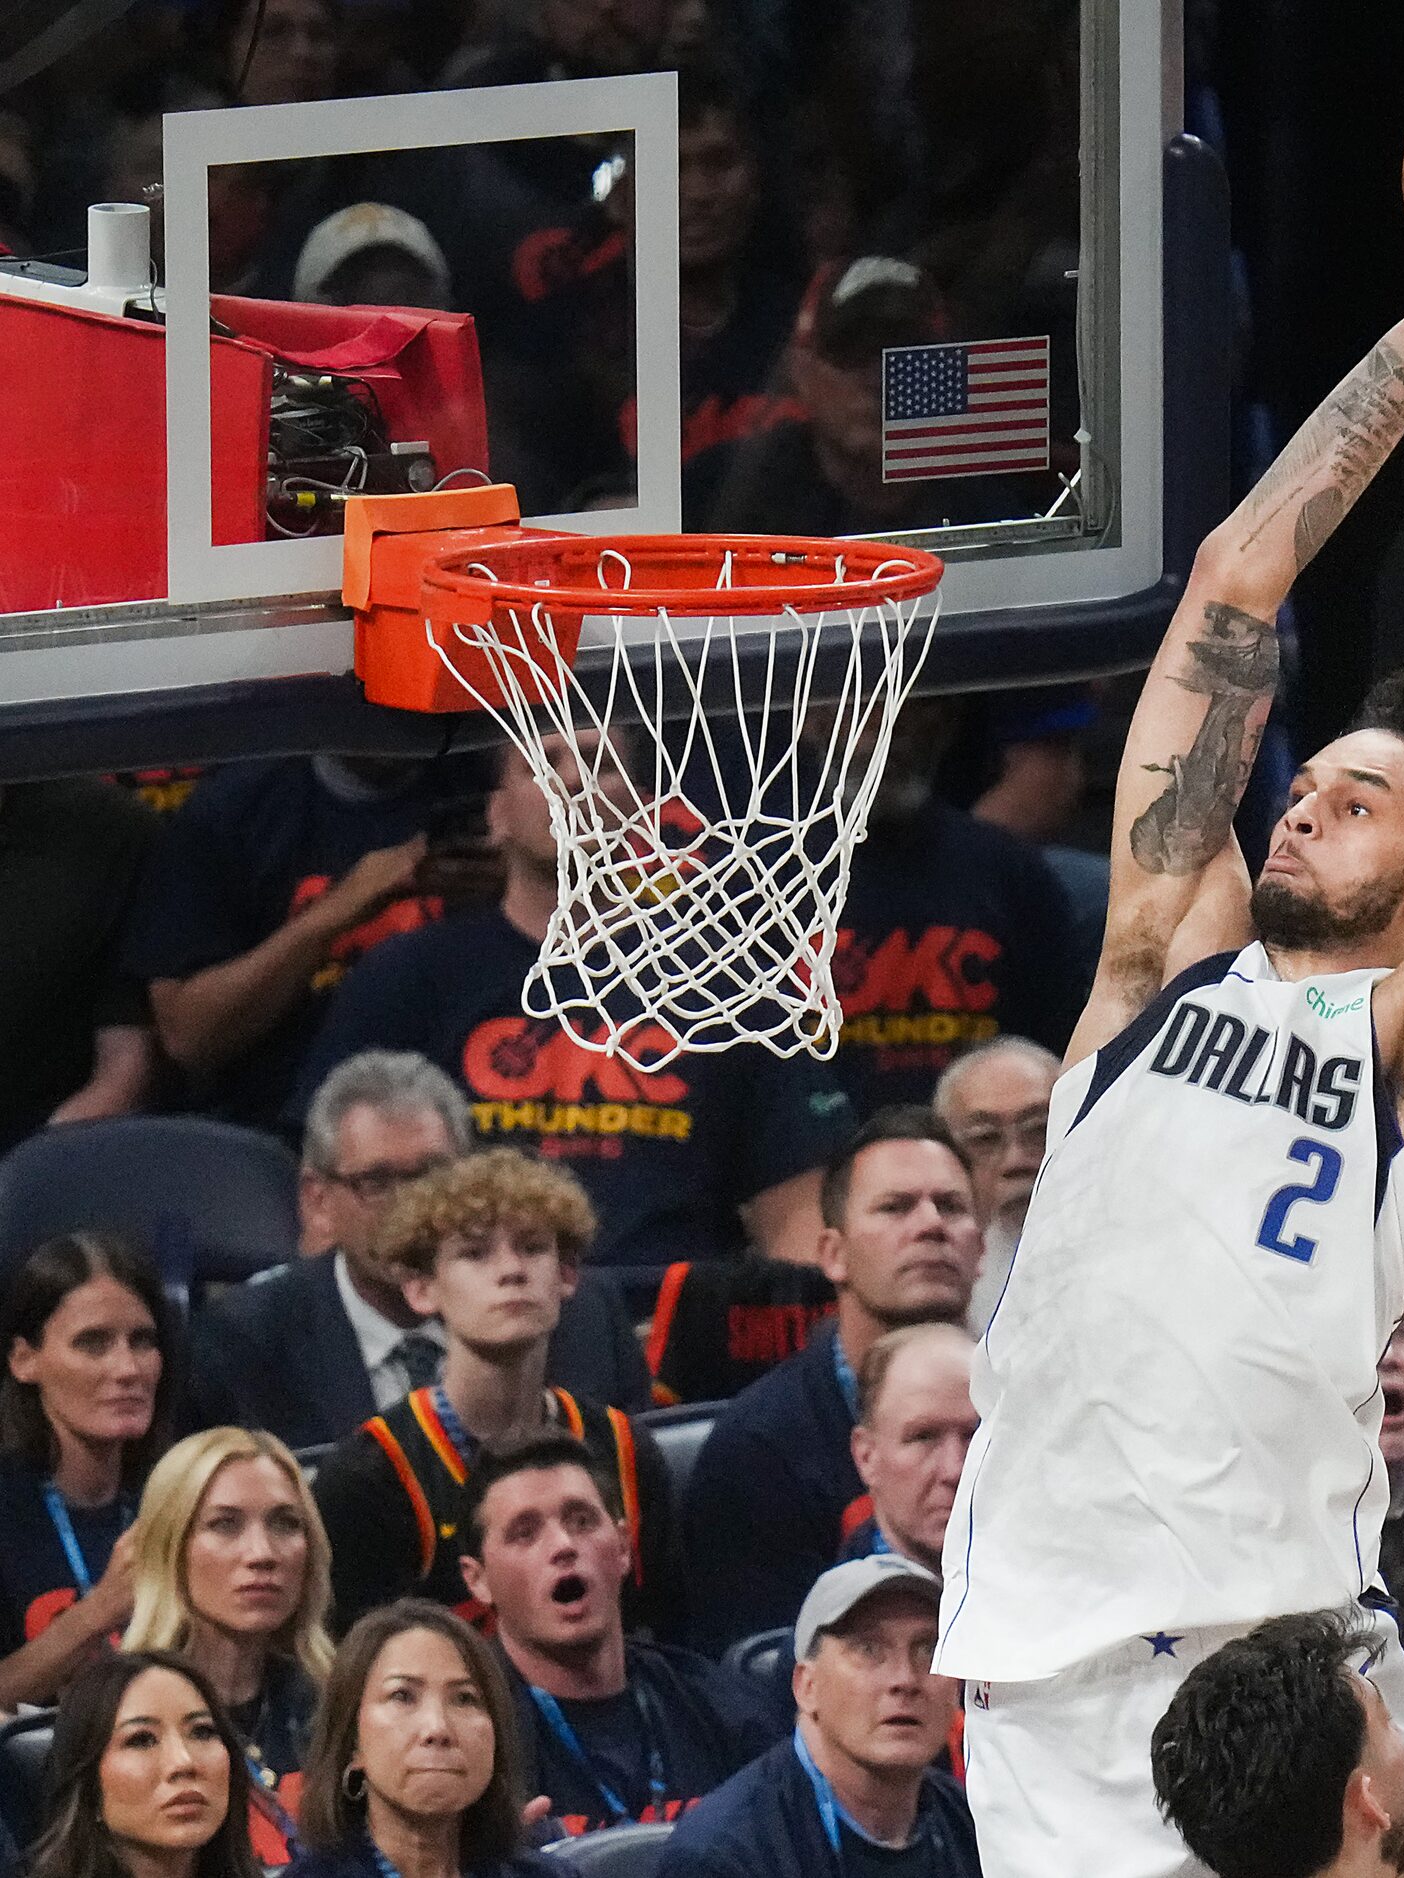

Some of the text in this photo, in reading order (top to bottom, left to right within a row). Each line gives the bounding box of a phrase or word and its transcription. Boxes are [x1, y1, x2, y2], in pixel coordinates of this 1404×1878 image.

[463, 1016, 690, 1104] OKC
[1148, 1001, 1365, 1133] DALLAS
[470, 1100, 694, 1142] THUNDER
[1254, 1136, 1346, 1266] 2
